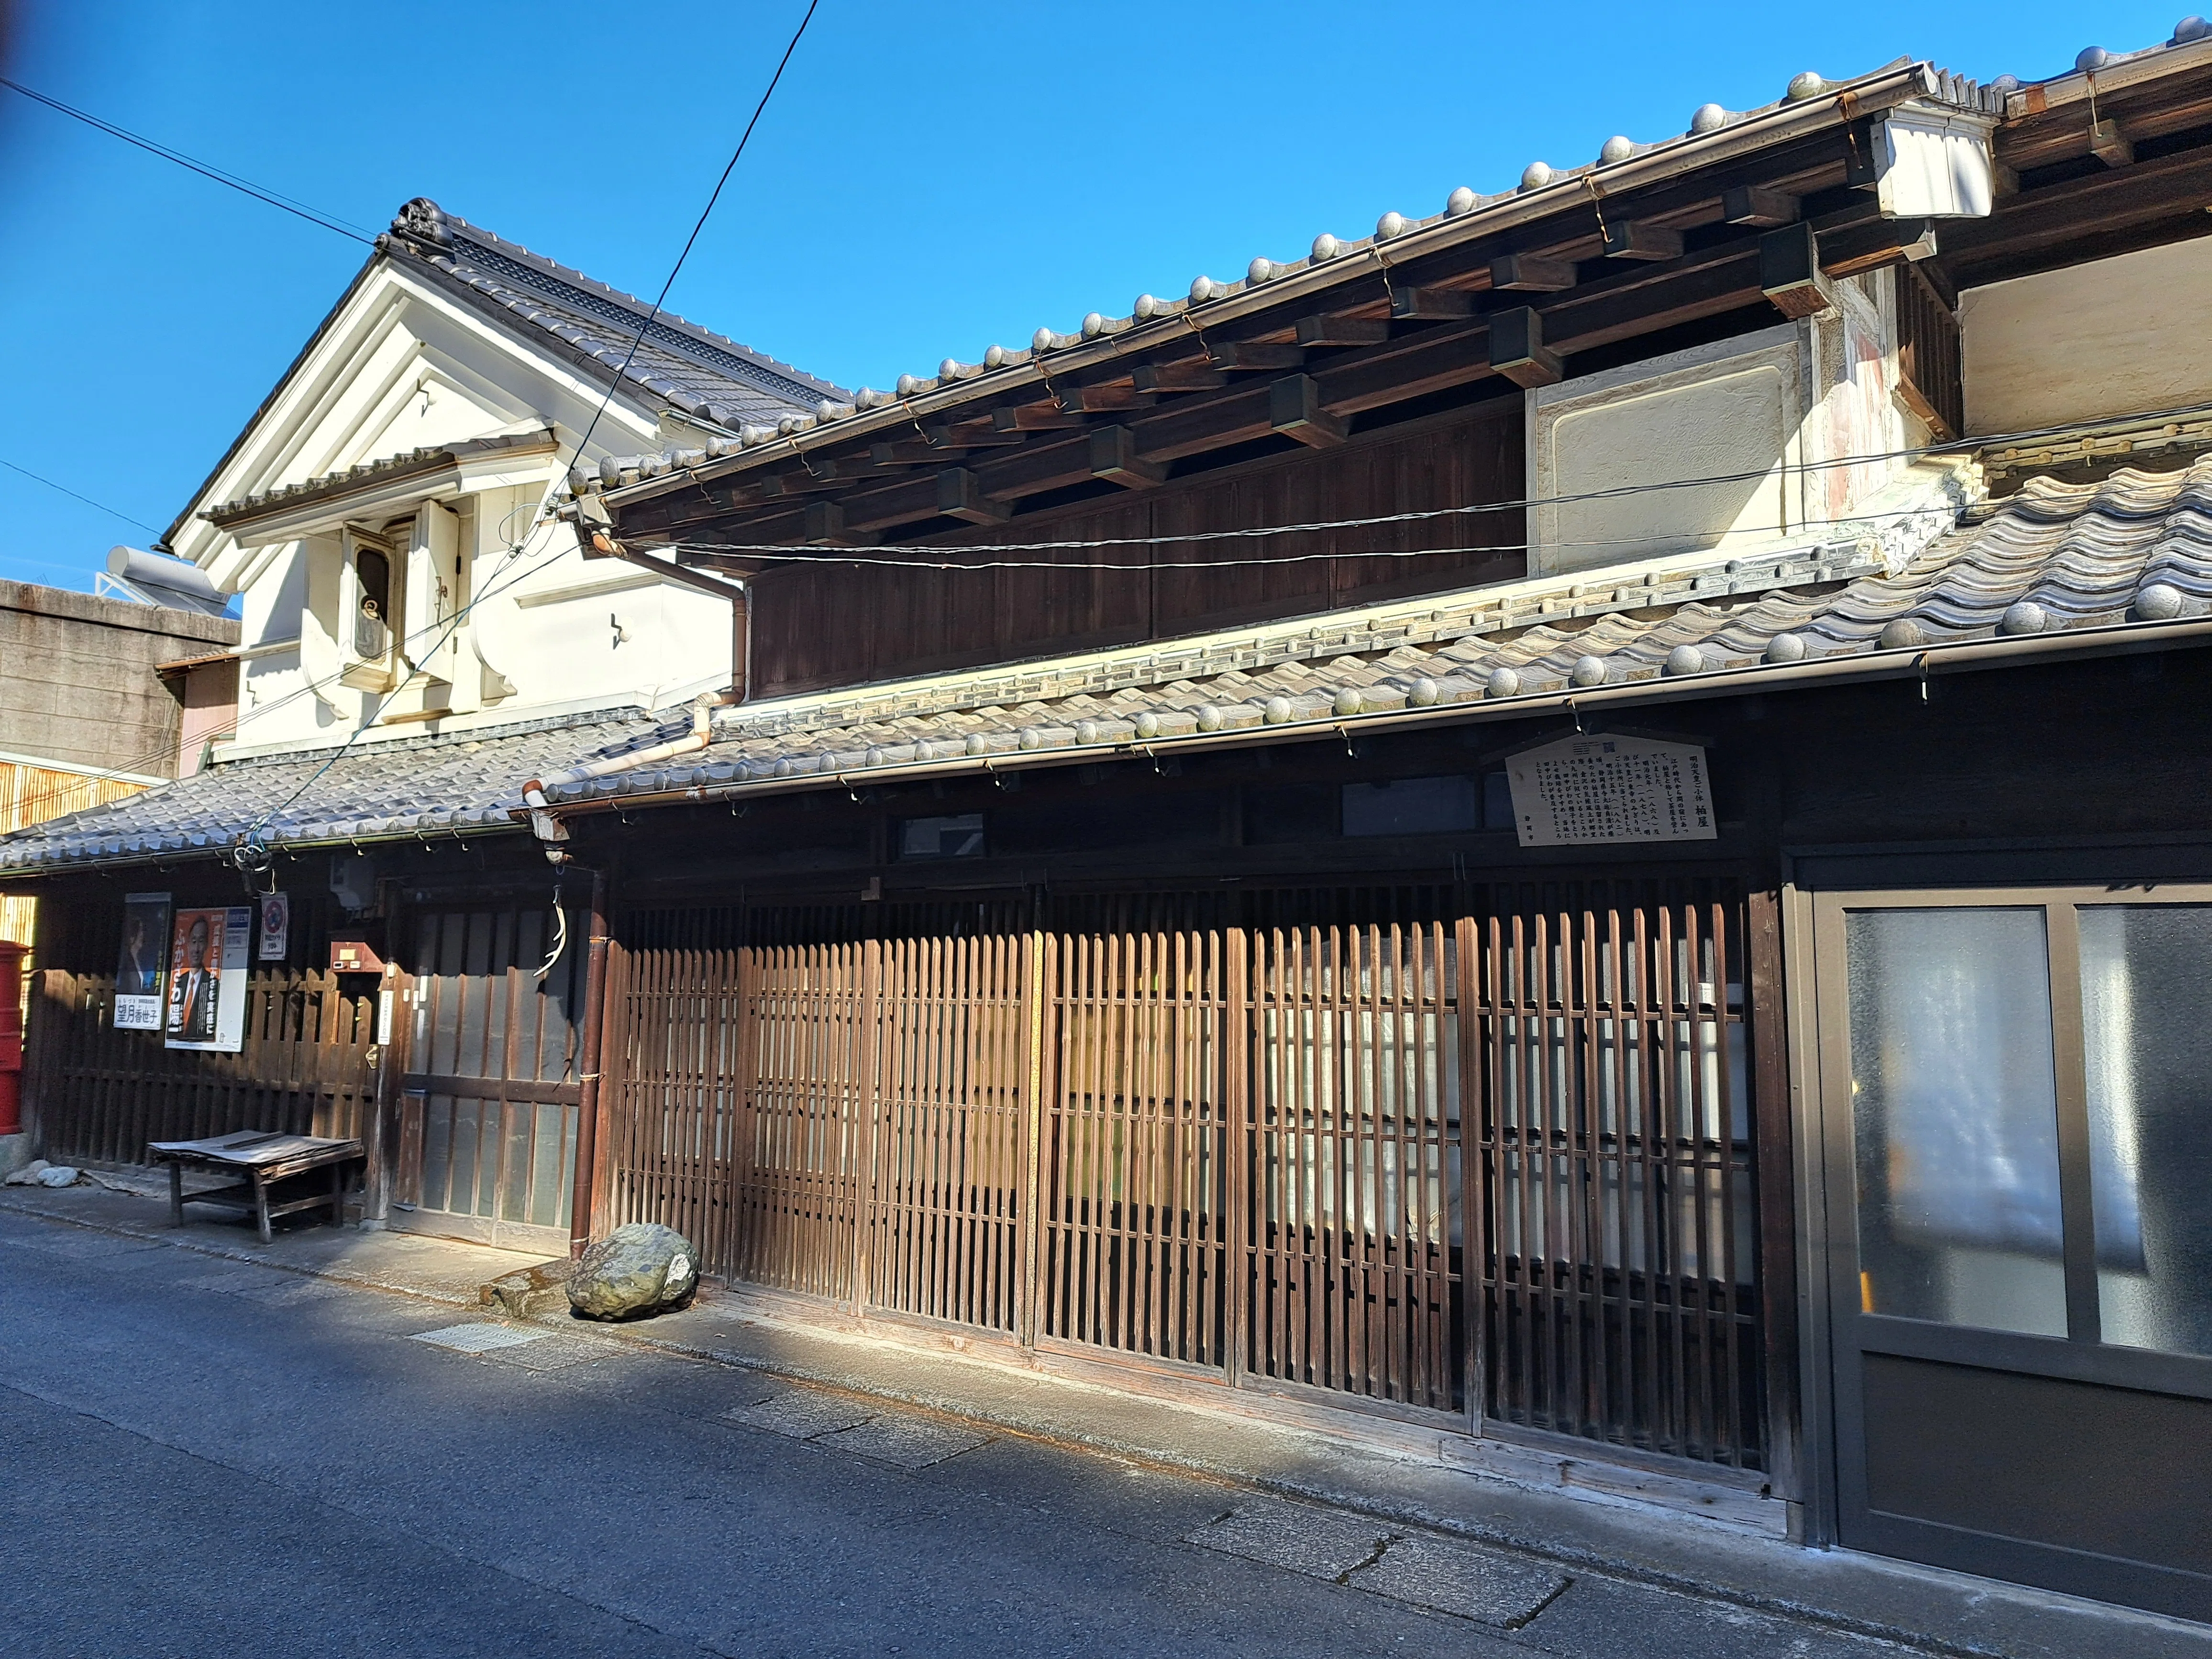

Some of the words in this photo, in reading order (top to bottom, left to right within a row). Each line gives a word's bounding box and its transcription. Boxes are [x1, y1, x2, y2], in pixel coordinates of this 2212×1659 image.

[1651, 753, 1662, 786] でいました。
[1695, 805, 1709, 827] 柏屋
[117, 1004, 157, 1024] 望月香世子
